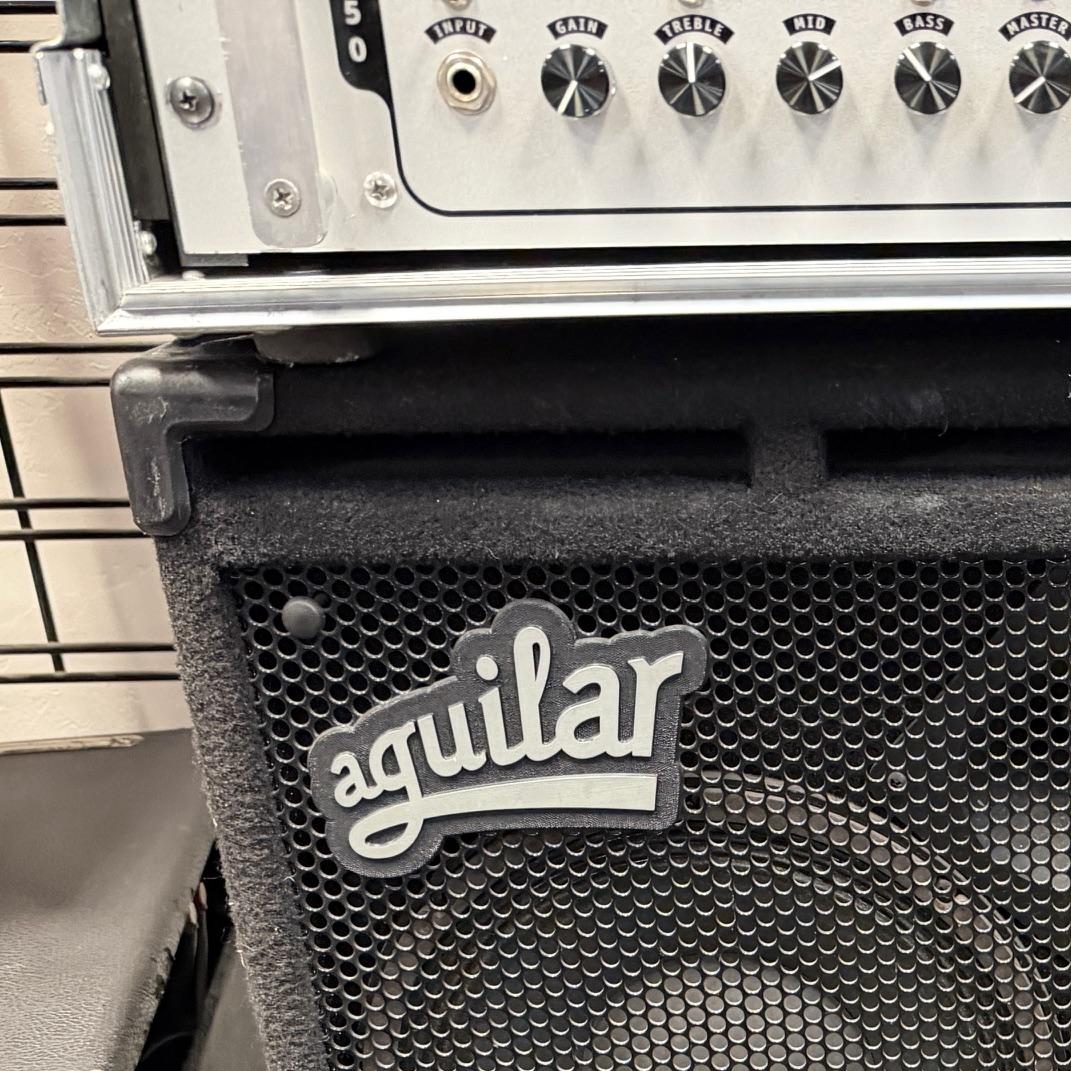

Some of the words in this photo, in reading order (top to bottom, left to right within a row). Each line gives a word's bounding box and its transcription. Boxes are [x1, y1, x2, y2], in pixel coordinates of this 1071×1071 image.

[432, 19, 487, 38] INPUT
[555, 18, 599, 34] GAIN
[661, 16, 724, 37] TREBLE
[793, 16, 826, 31] MID
[902, 15, 945, 31] BASS
[1006, 13, 1069, 35] MASTER
[330, 626, 684, 859] aguilar
